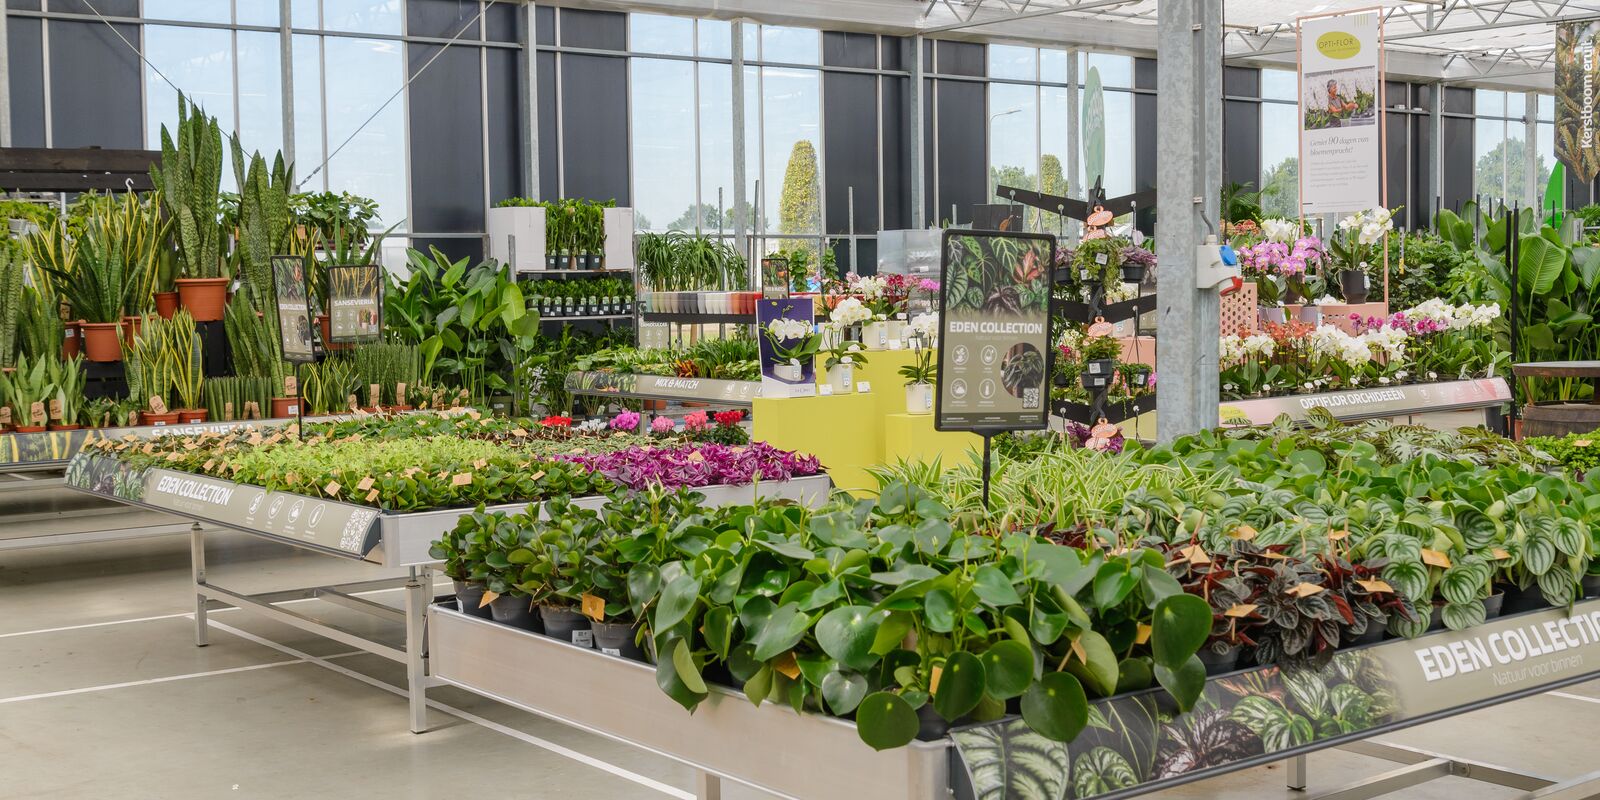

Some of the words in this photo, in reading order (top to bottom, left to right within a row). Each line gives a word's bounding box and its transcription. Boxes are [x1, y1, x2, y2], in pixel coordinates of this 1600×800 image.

[1581, 75, 1593, 149] Kerstboom
[949, 321, 979, 333] EDEN
[980, 321, 1043, 334] COLLECTION
[654, 378, 670, 388] MIX
[673, 379, 700, 390] MATCH
[1300, 395, 1348, 410] OPTIFLOR
[157, 475, 182, 495] EDEN
[179, 479, 235, 506] COLLECTION
[1414, 637, 1492, 682] EDEN
[1492, 667, 1528, 687] Natuur
[1528, 662, 1550, 678] voor
[1550, 654, 1584, 673] binnen
